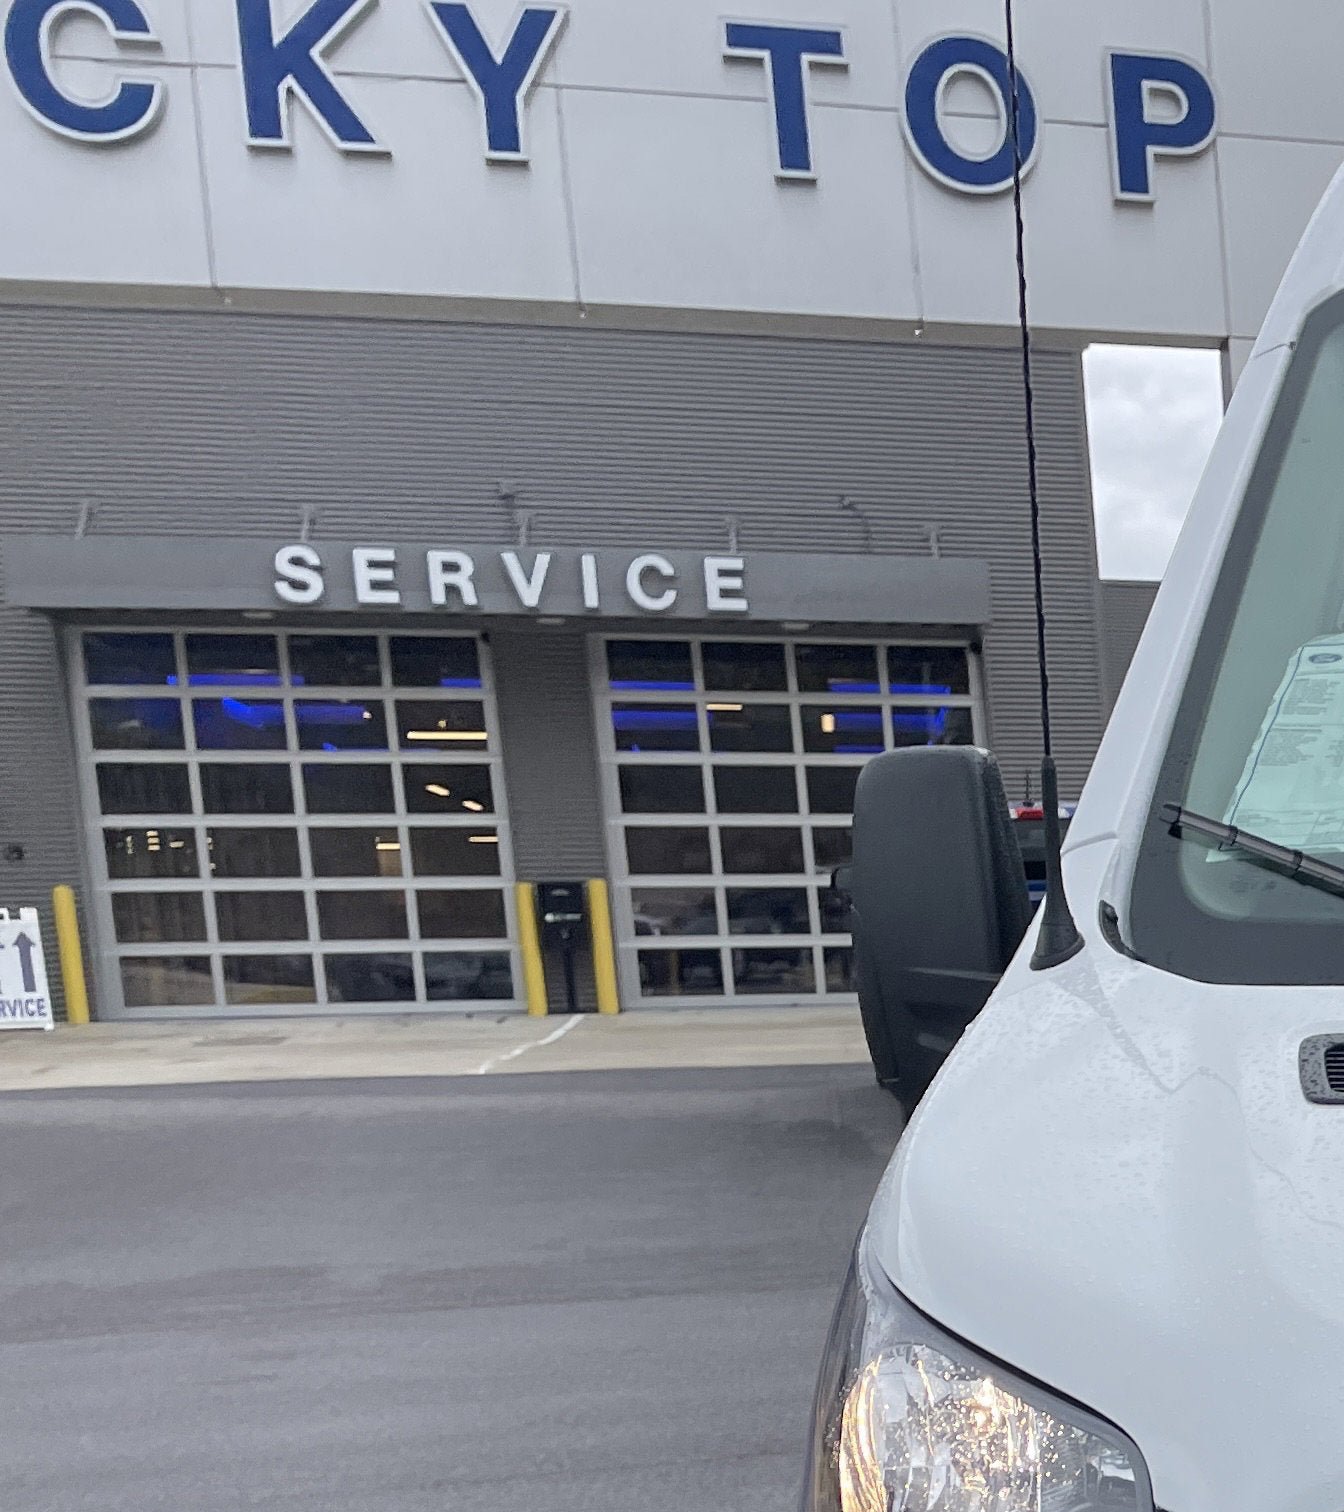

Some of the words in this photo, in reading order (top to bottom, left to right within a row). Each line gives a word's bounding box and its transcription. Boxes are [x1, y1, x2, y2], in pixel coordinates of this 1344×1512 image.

[3, 0, 568, 163] CKY
[722, 19, 1219, 203] TOP
[274, 543, 750, 612] SERVICE
